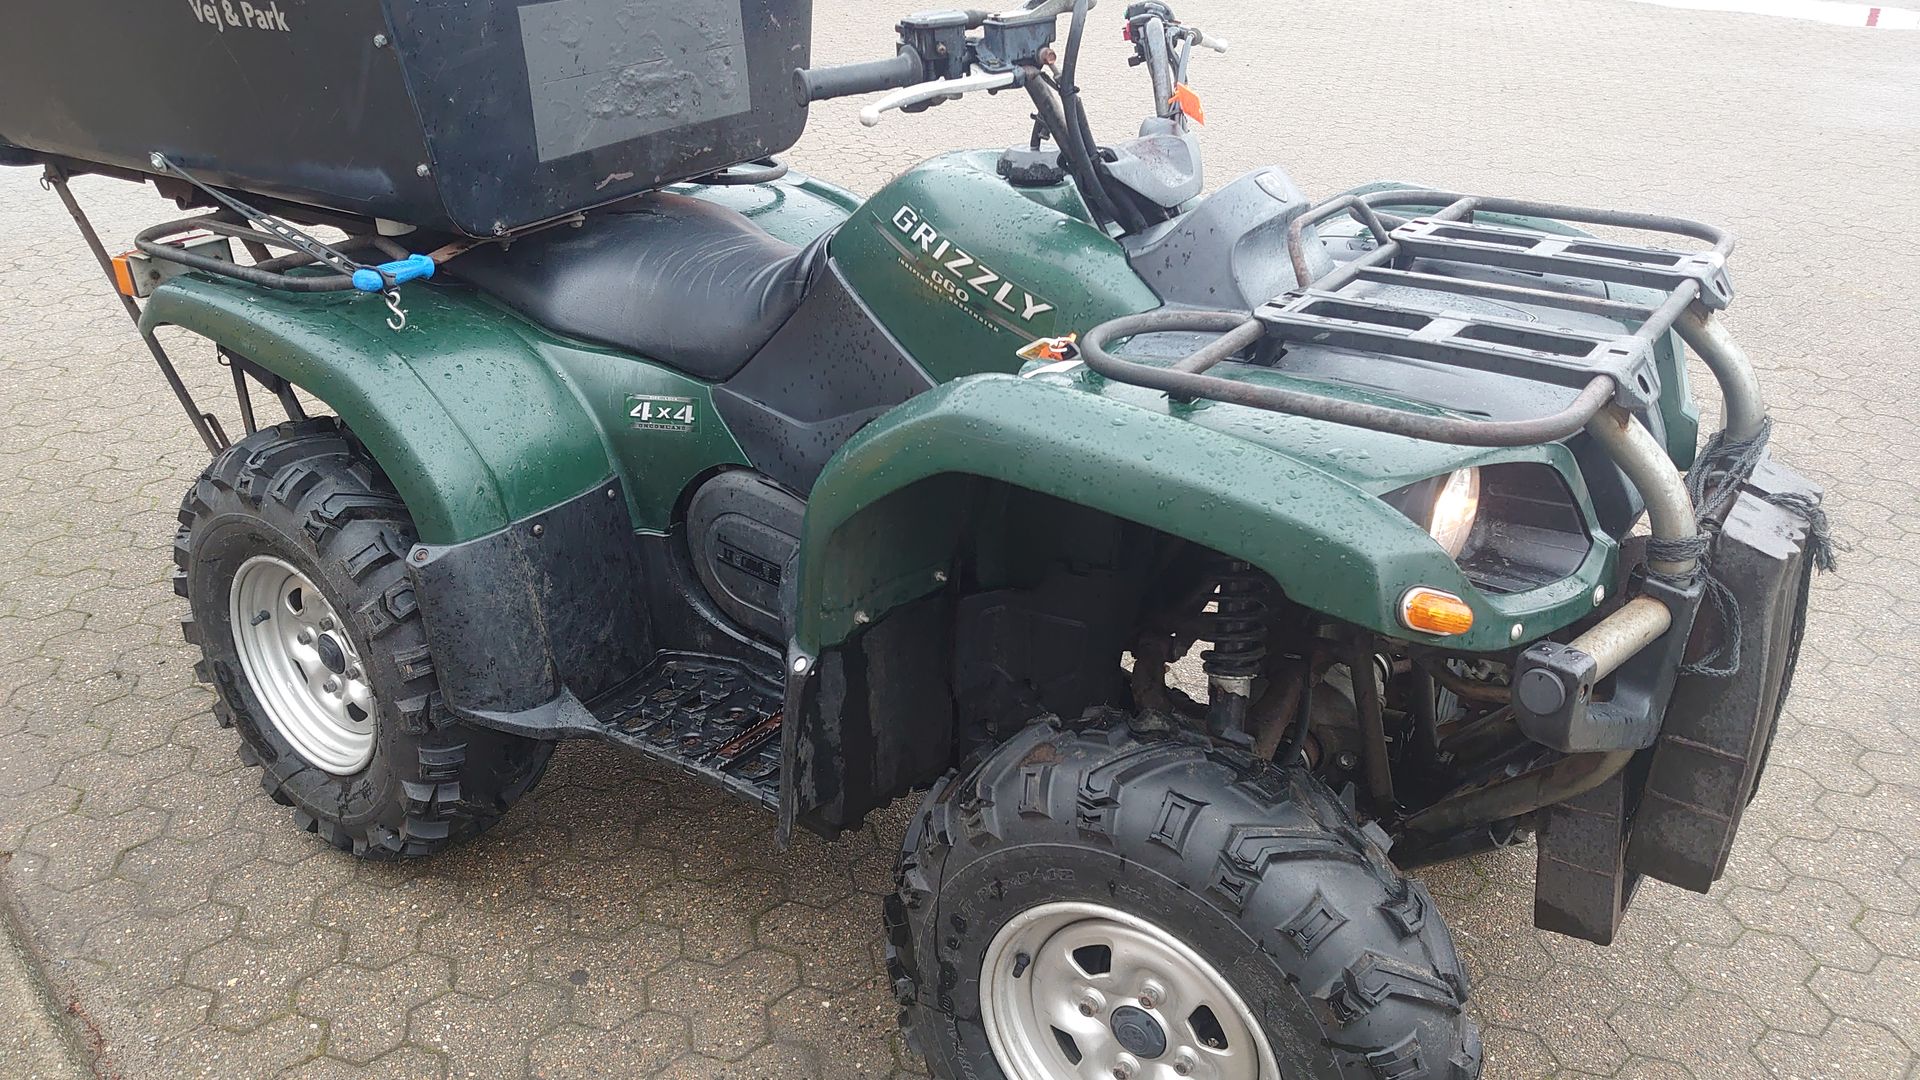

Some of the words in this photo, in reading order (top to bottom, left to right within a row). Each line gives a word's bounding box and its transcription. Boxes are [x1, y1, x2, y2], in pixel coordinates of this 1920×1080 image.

[188, 0, 224, 32] Vej
[221, 0, 242, 27] &
[240, 1, 291, 32] Park
[892, 205, 1054, 321] GRIZZLY
[931, 270, 970, 303] 660
